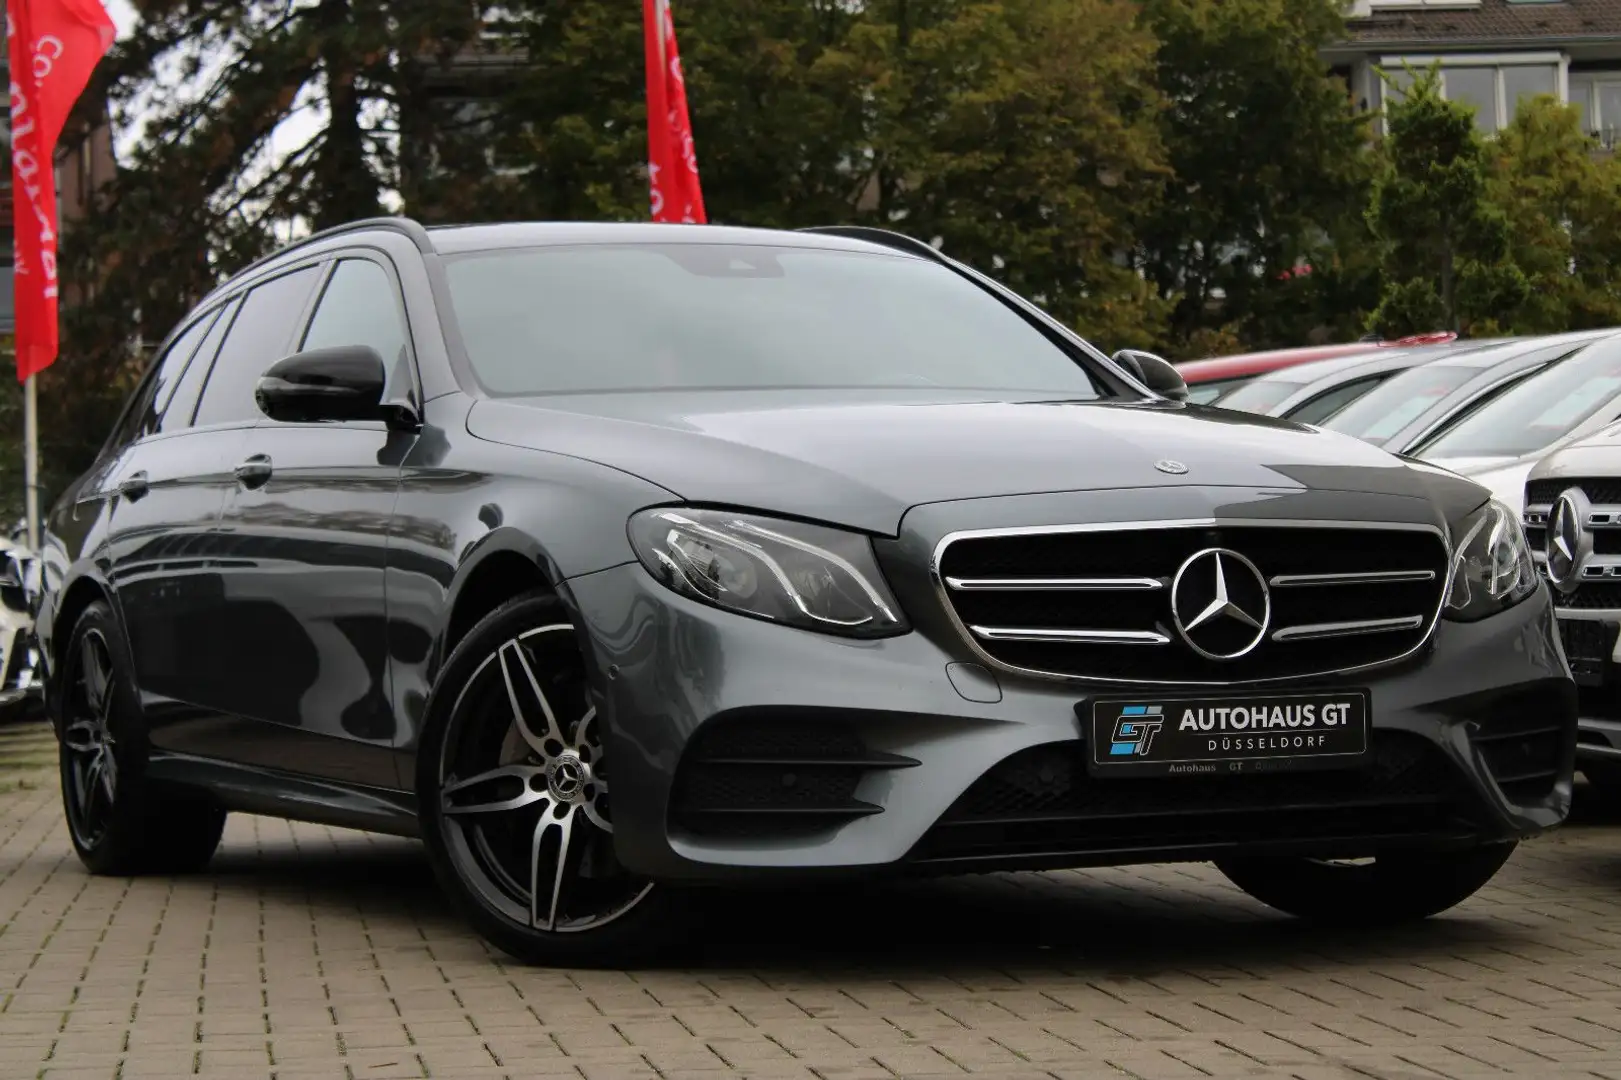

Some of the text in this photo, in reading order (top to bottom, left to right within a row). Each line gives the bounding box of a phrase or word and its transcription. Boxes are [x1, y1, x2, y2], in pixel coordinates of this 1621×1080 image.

[1178, 703, 1351, 731] AUTOHAUS GT
[1208, 735, 1327, 751] DÜSSELDORF
[1168, 763, 1217, 773] Autohaus
